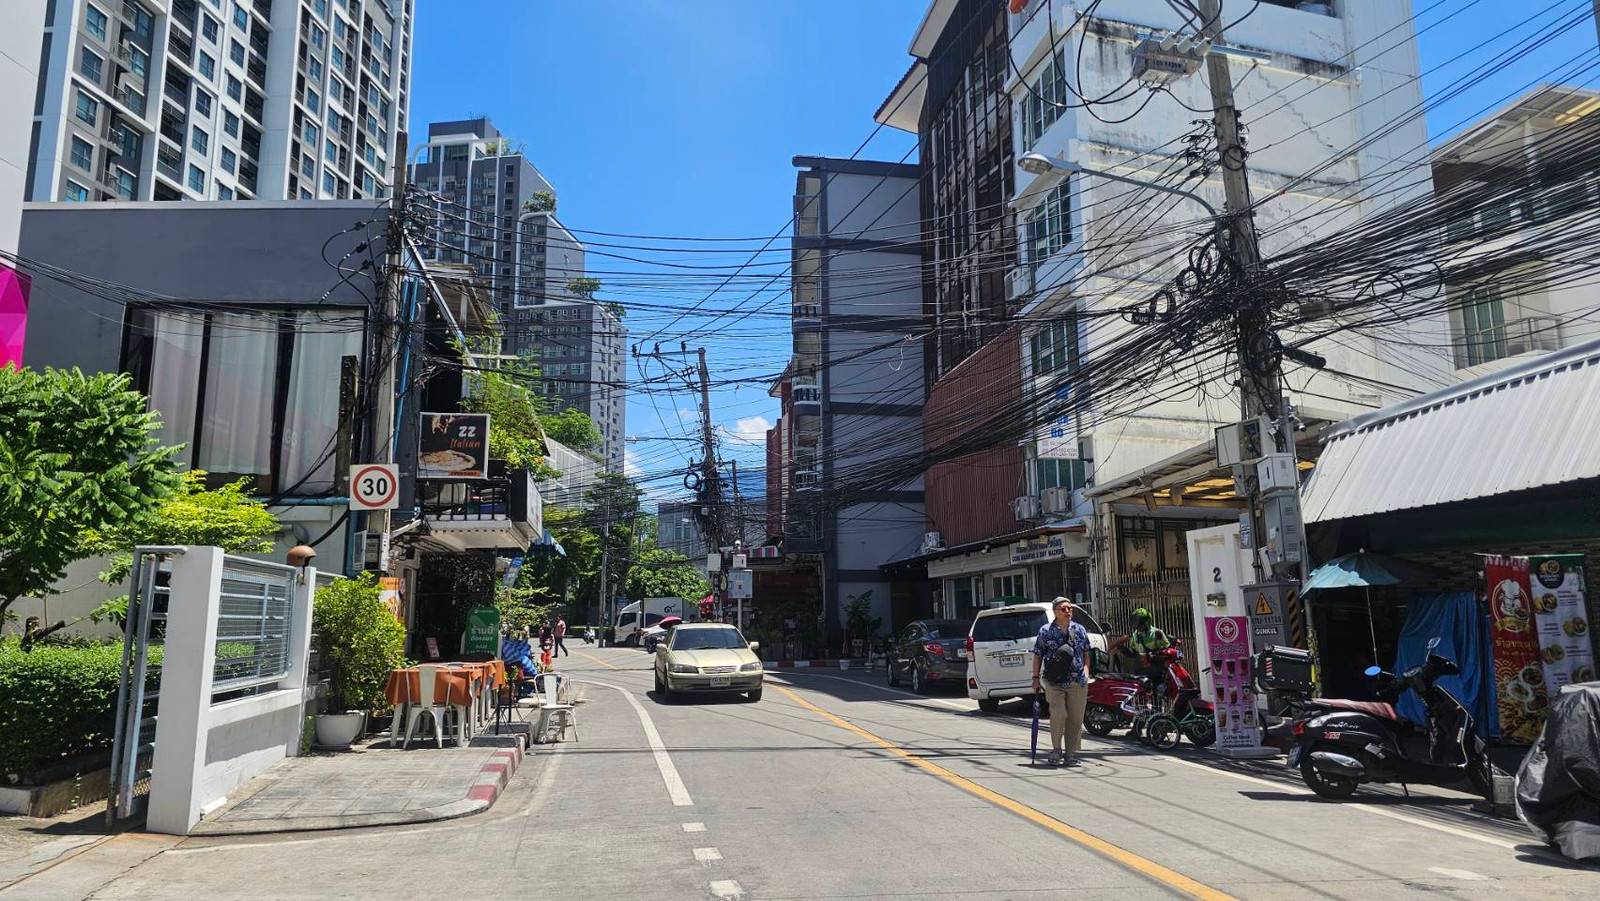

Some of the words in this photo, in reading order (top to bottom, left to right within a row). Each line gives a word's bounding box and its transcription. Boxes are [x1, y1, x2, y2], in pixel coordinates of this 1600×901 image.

[450, 438, 480, 449] Italian
[362, 477, 387, 496] 30
[1213, 567, 1221, 582] 2
